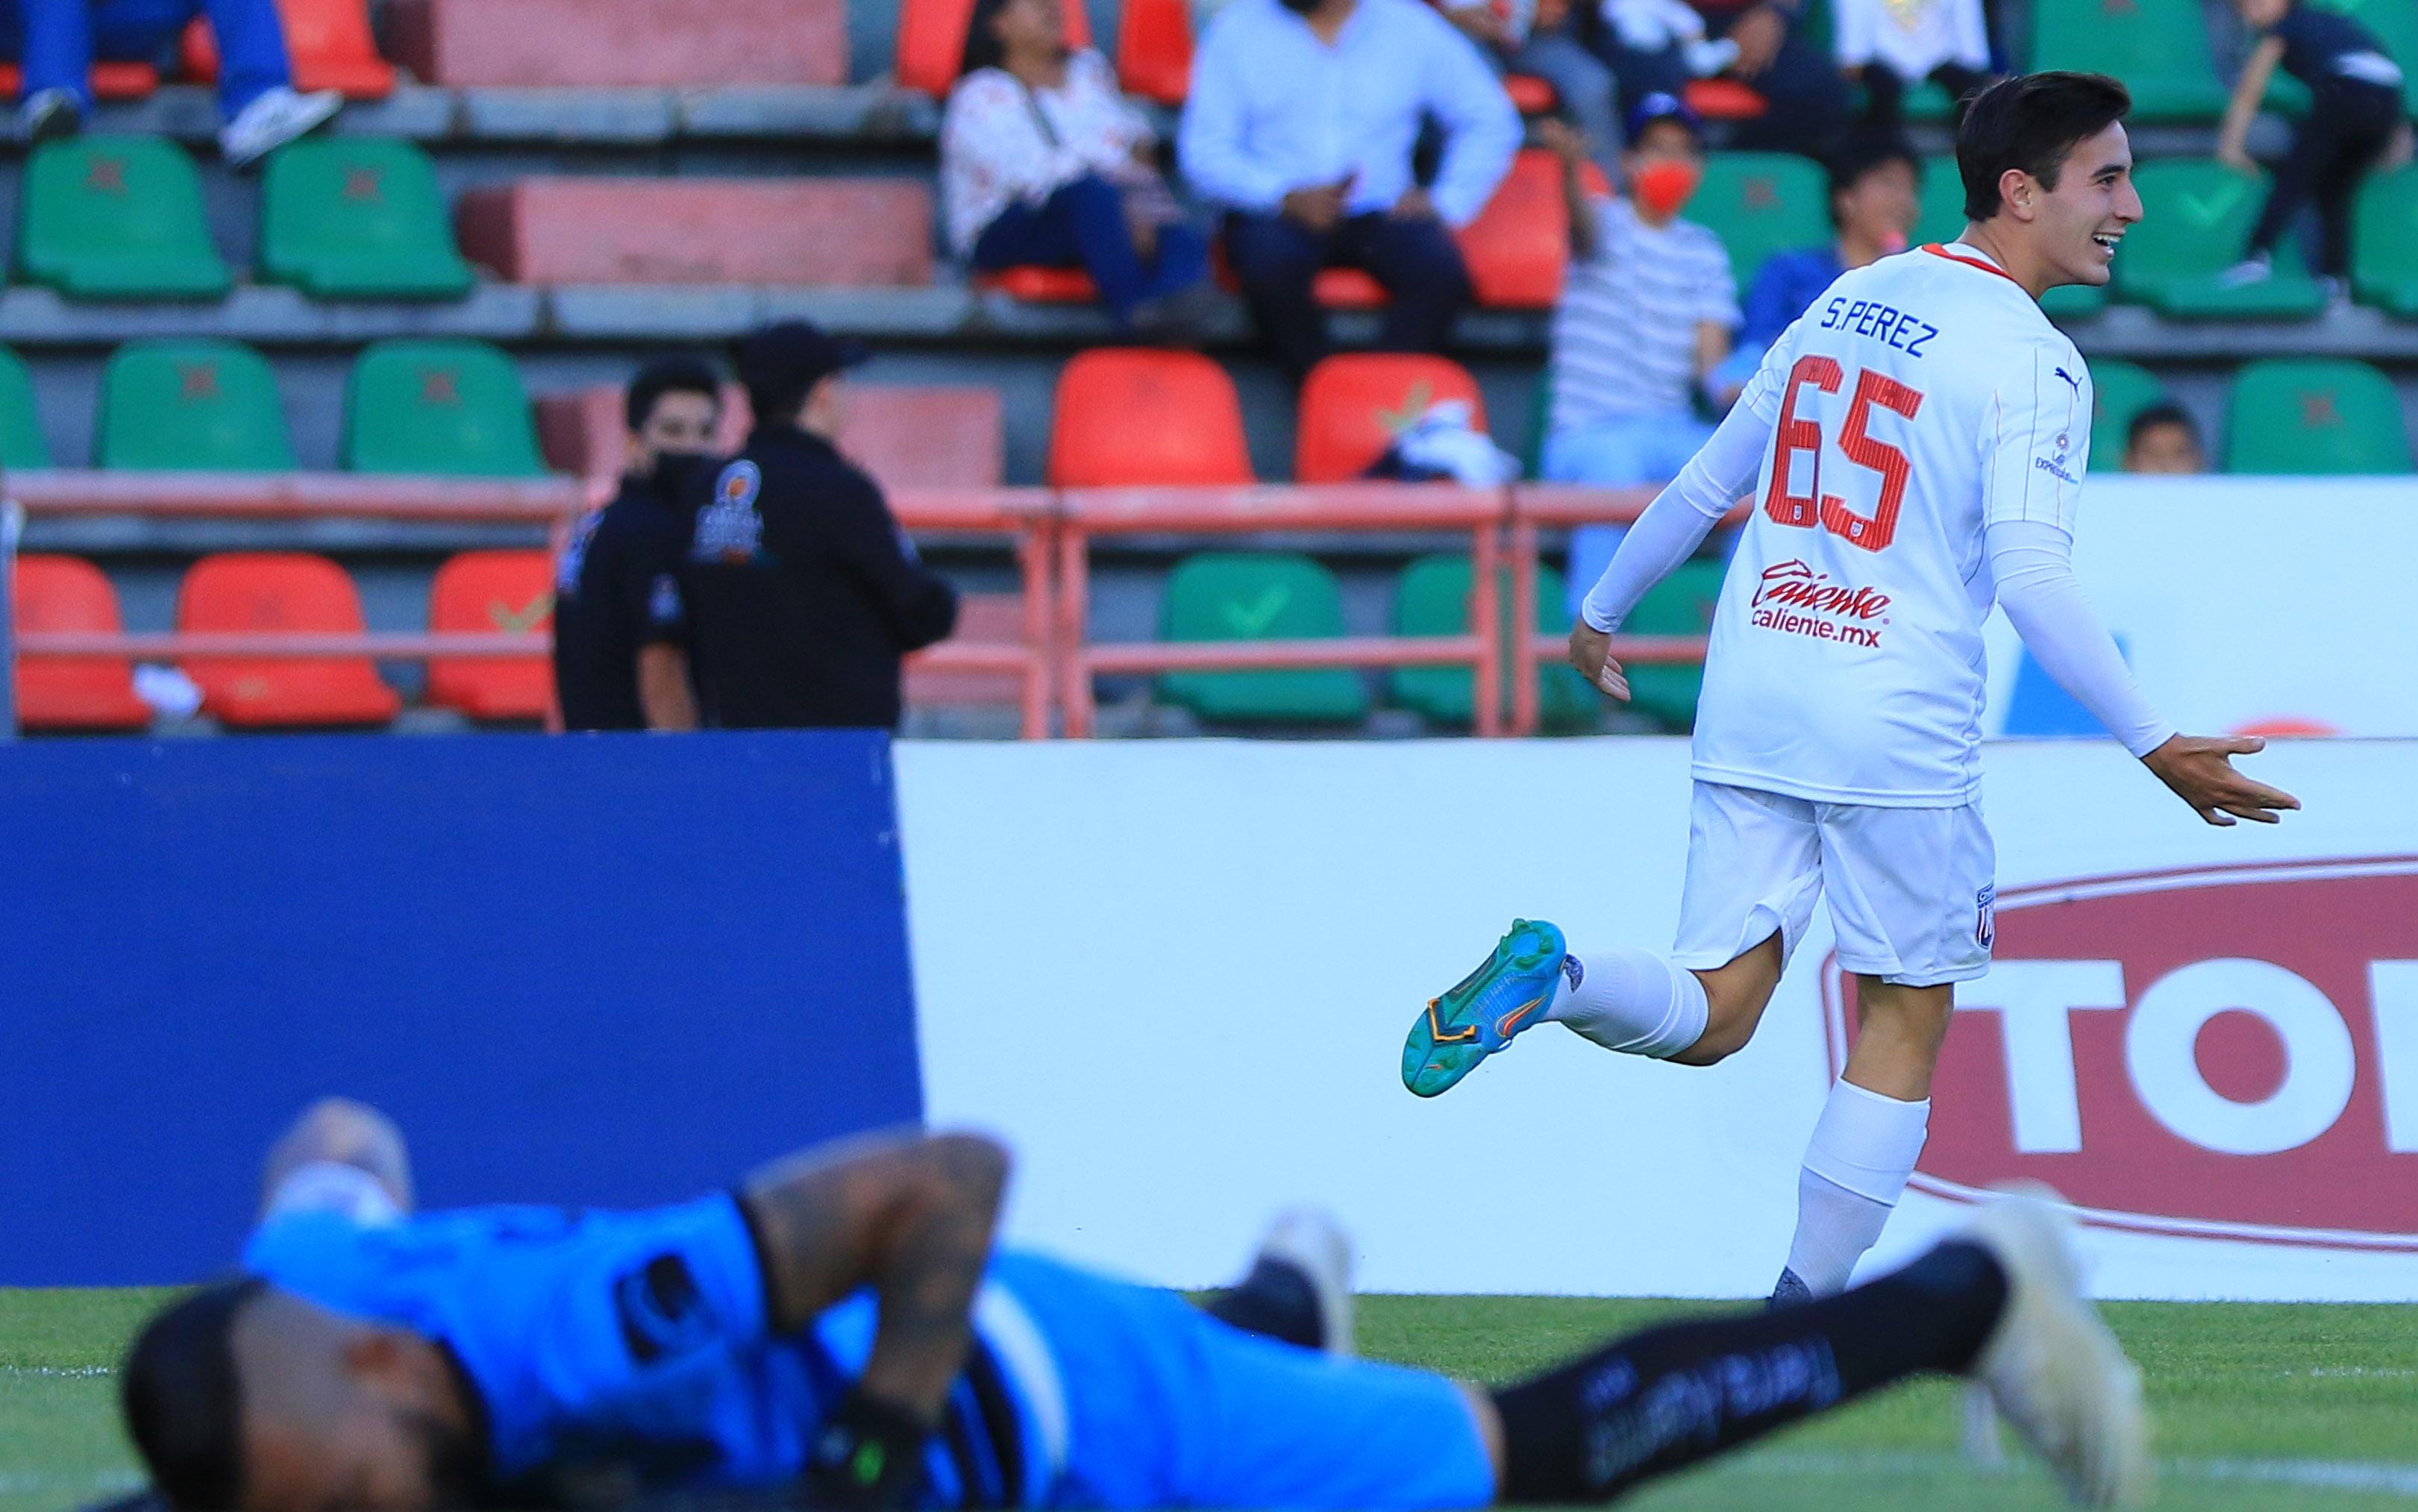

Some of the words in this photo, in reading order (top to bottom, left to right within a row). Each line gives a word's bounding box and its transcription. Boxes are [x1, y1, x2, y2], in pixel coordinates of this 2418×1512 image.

[1820, 297, 1939, 358] S.PEREZ
[1764, 354, 1925, 553] 65
[1751, 558, 1892, 620] Caliente
[1751, 608, 1882, 648] caliente.mx
